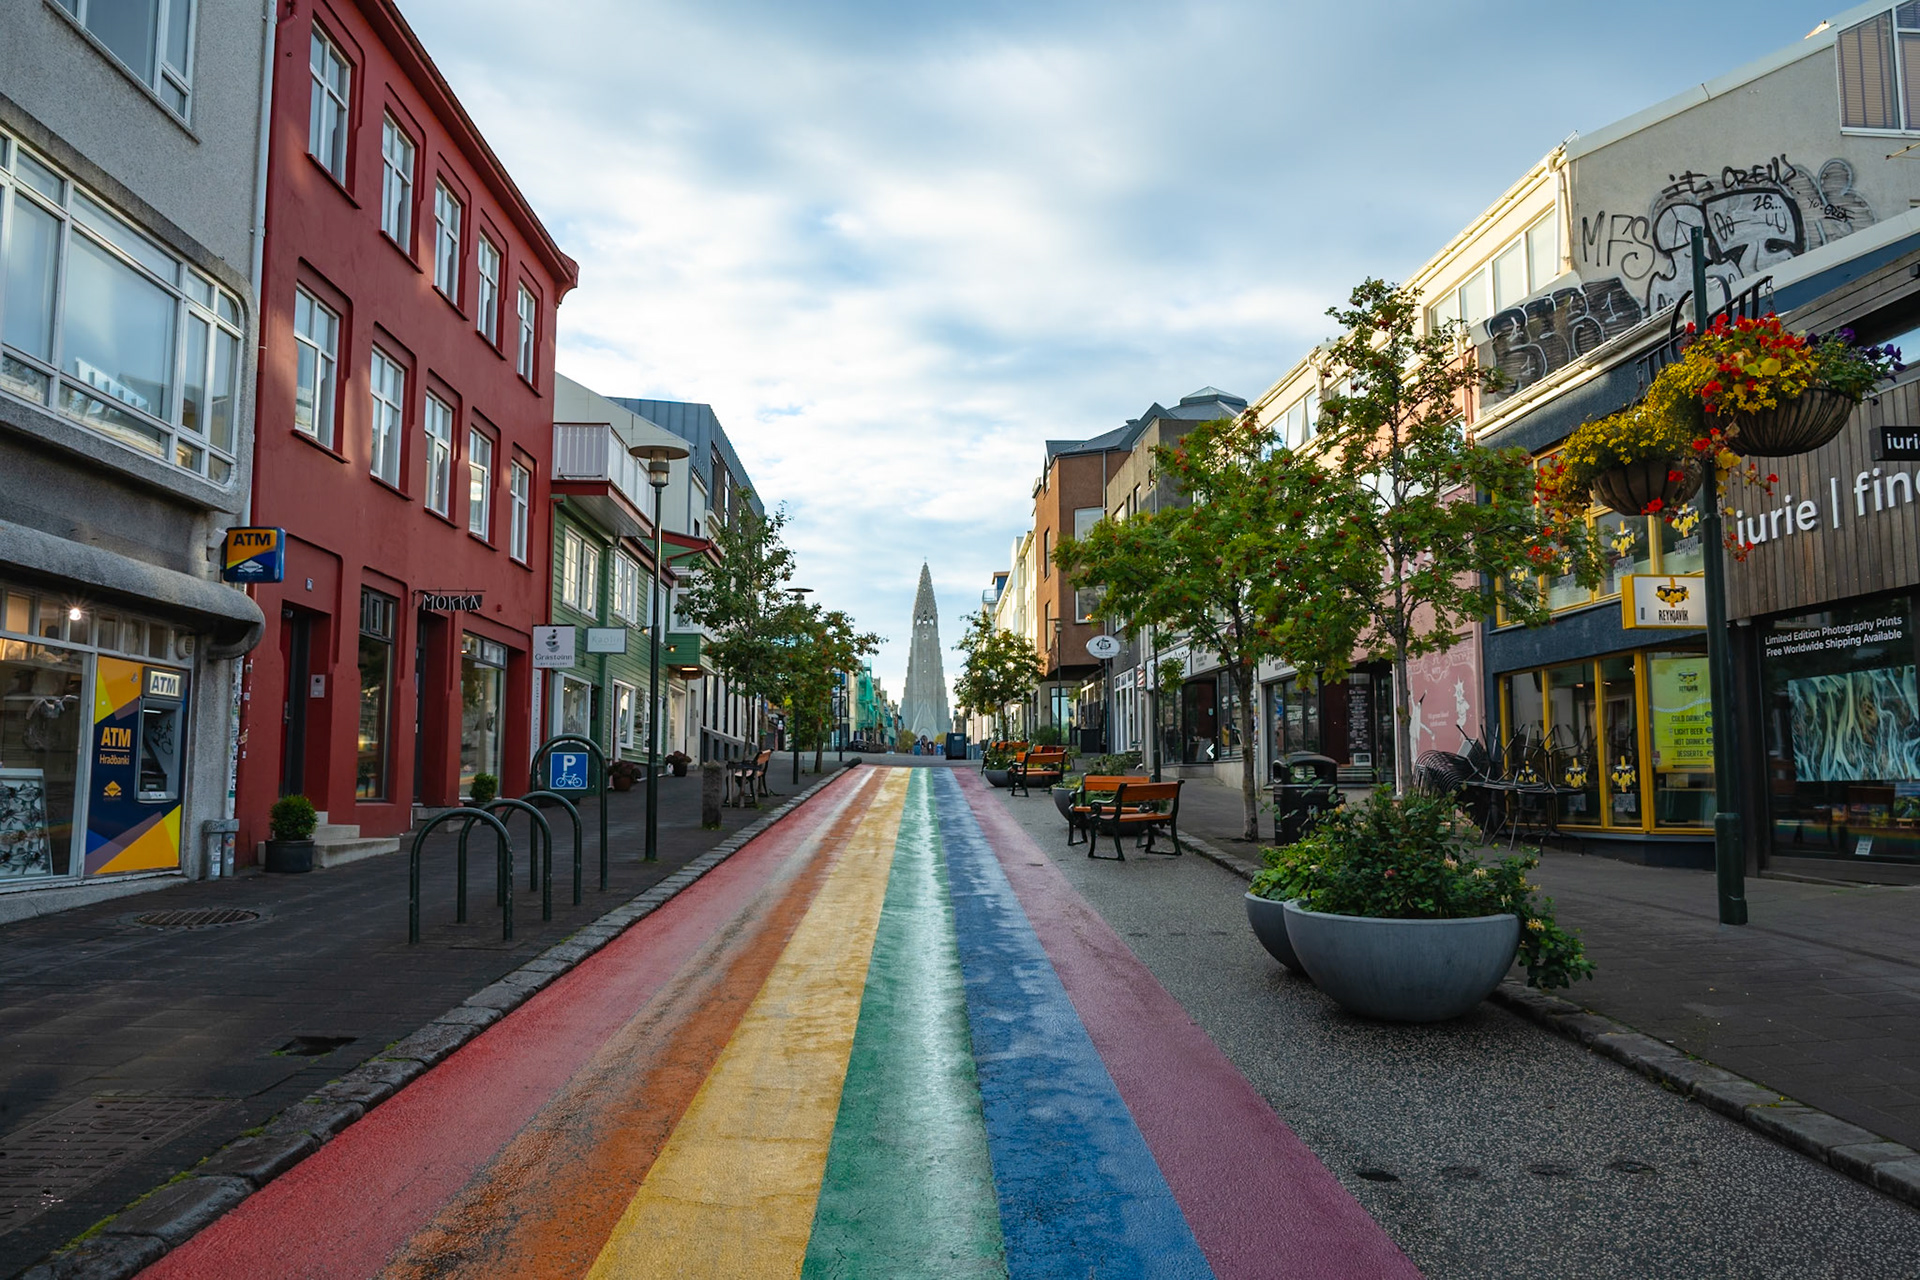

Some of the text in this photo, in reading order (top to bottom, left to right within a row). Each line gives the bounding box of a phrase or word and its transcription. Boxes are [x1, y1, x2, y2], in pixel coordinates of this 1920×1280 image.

[1887, 433, 1920, 450] iuri
[1736, 494, 1818, 547] iurie
[1853, 467, 1920, 517] fin
[233, 533, 271, 546] ATM
[423, 594, 480, 612] MOKKA
[1765, 616, 1902, 645] Limited Edition Photography Prints
[1766, 629, 1902, 657] Free Worldwide Shipping Available
[151, 676, 176, 694] ATM
[100, 726, 132, 748] ATM
[1674, 727, 1704, 735] LIGHT BEER
[99, 754, 130, 765] Hraðbanki
[563, 755, 577, 771] P
